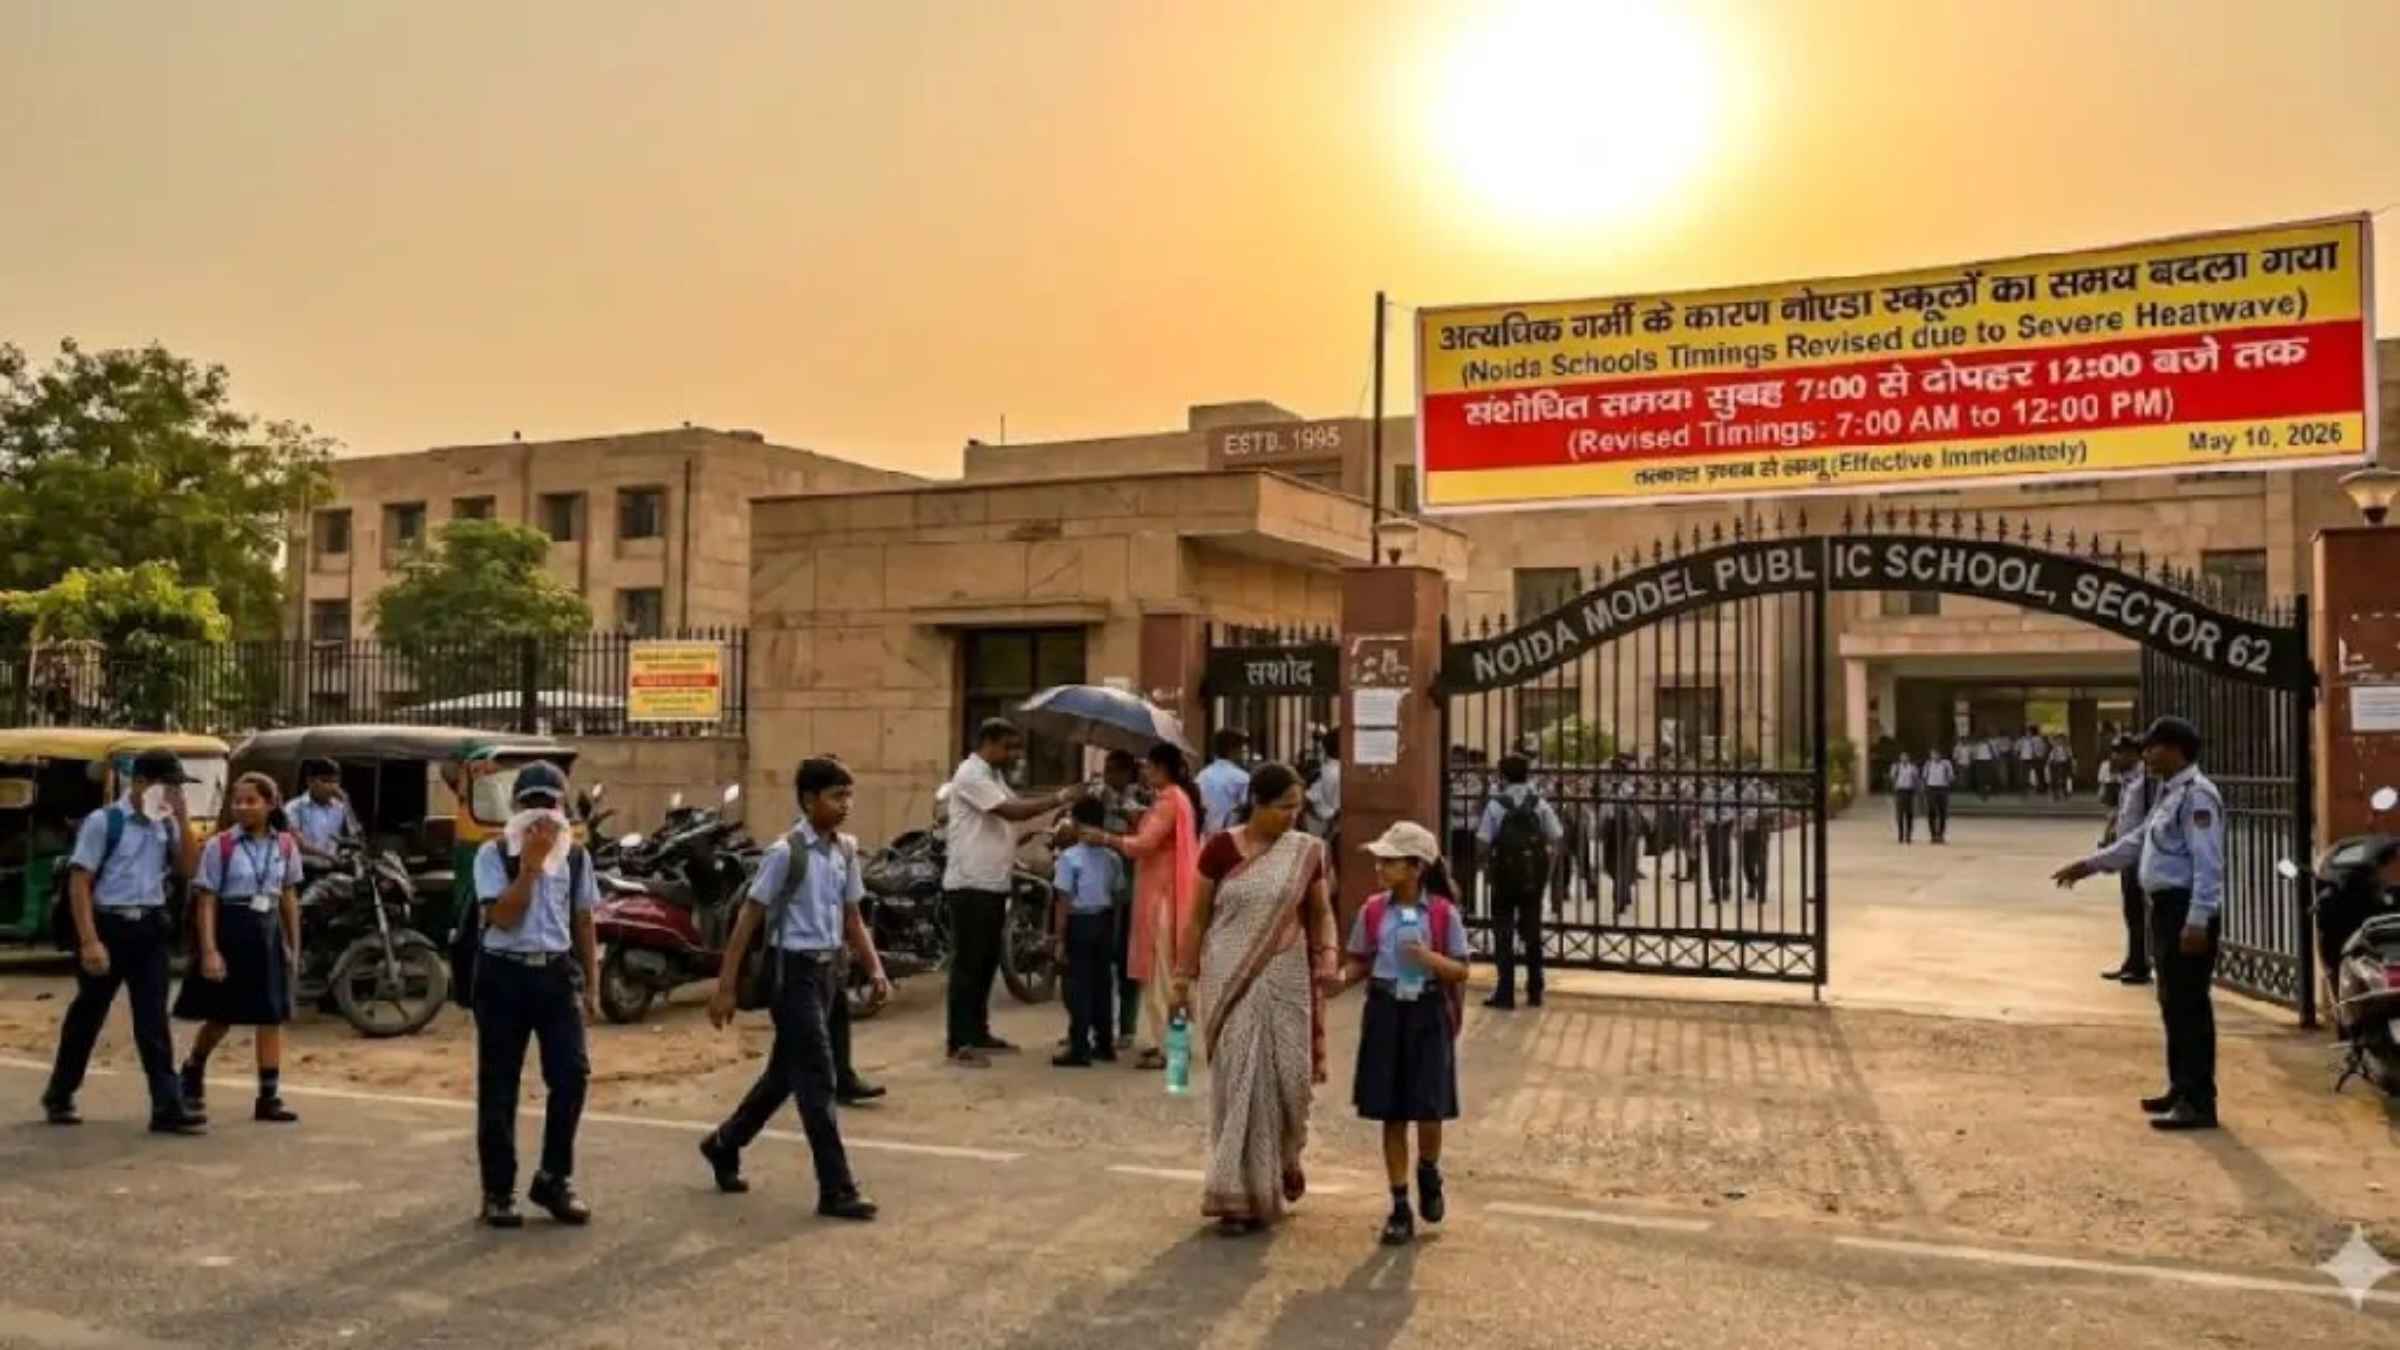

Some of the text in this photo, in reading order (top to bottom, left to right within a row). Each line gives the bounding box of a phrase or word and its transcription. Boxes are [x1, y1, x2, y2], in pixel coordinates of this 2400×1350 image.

[1570, 302, 1636, 340] गर्मी
[1640, 299, 1675, 333] के
[1684, 301, 1772, 329] कारण
[1780, 286, 1874, 322] नोएडा
[1880, 269, 1984, 322] स्कूलों
[1990, 274, 2039, 302] का
[2048, 263, 2139, 299] समय
[2147, 252, 2248, 286] बदला
[2261, 240, 2339, 275] गया
[1462, 285, 2309, 388] (Noida Schools Timings Revised due to Severe Heatwave)
[1704, 380, 1785, 420] सुबह
[1795, 375, 1867, 403] 7:00
[1876, 363, 1911, 399] से
[1920, 358, 2037, 393] दोपहर
[2048, 352, 2142, 385] 12:00
[2151, 335, 2221, 374] बजे
[2231, 337, 2310, 369] तक
[1292, 425, 1342, 449] 1995
[1567, 386, 2174, 462] (Revised Timings: 7:00 AM to 12:00 PM)
[1942, 440, 2088, 468] Immediately)
[2188, 431, 2237, 455] May
[2287, 422, 2343, 446] 2026
[1472, 621, 1579, 683] NOIDA
[1582, 567, 1707, 636] MODEL
[1885, 543, 2057, 605] SCHOOL,
[2071, 574, 2222, 662] SECTOR
[2226, 635, 2272, 674] 62
